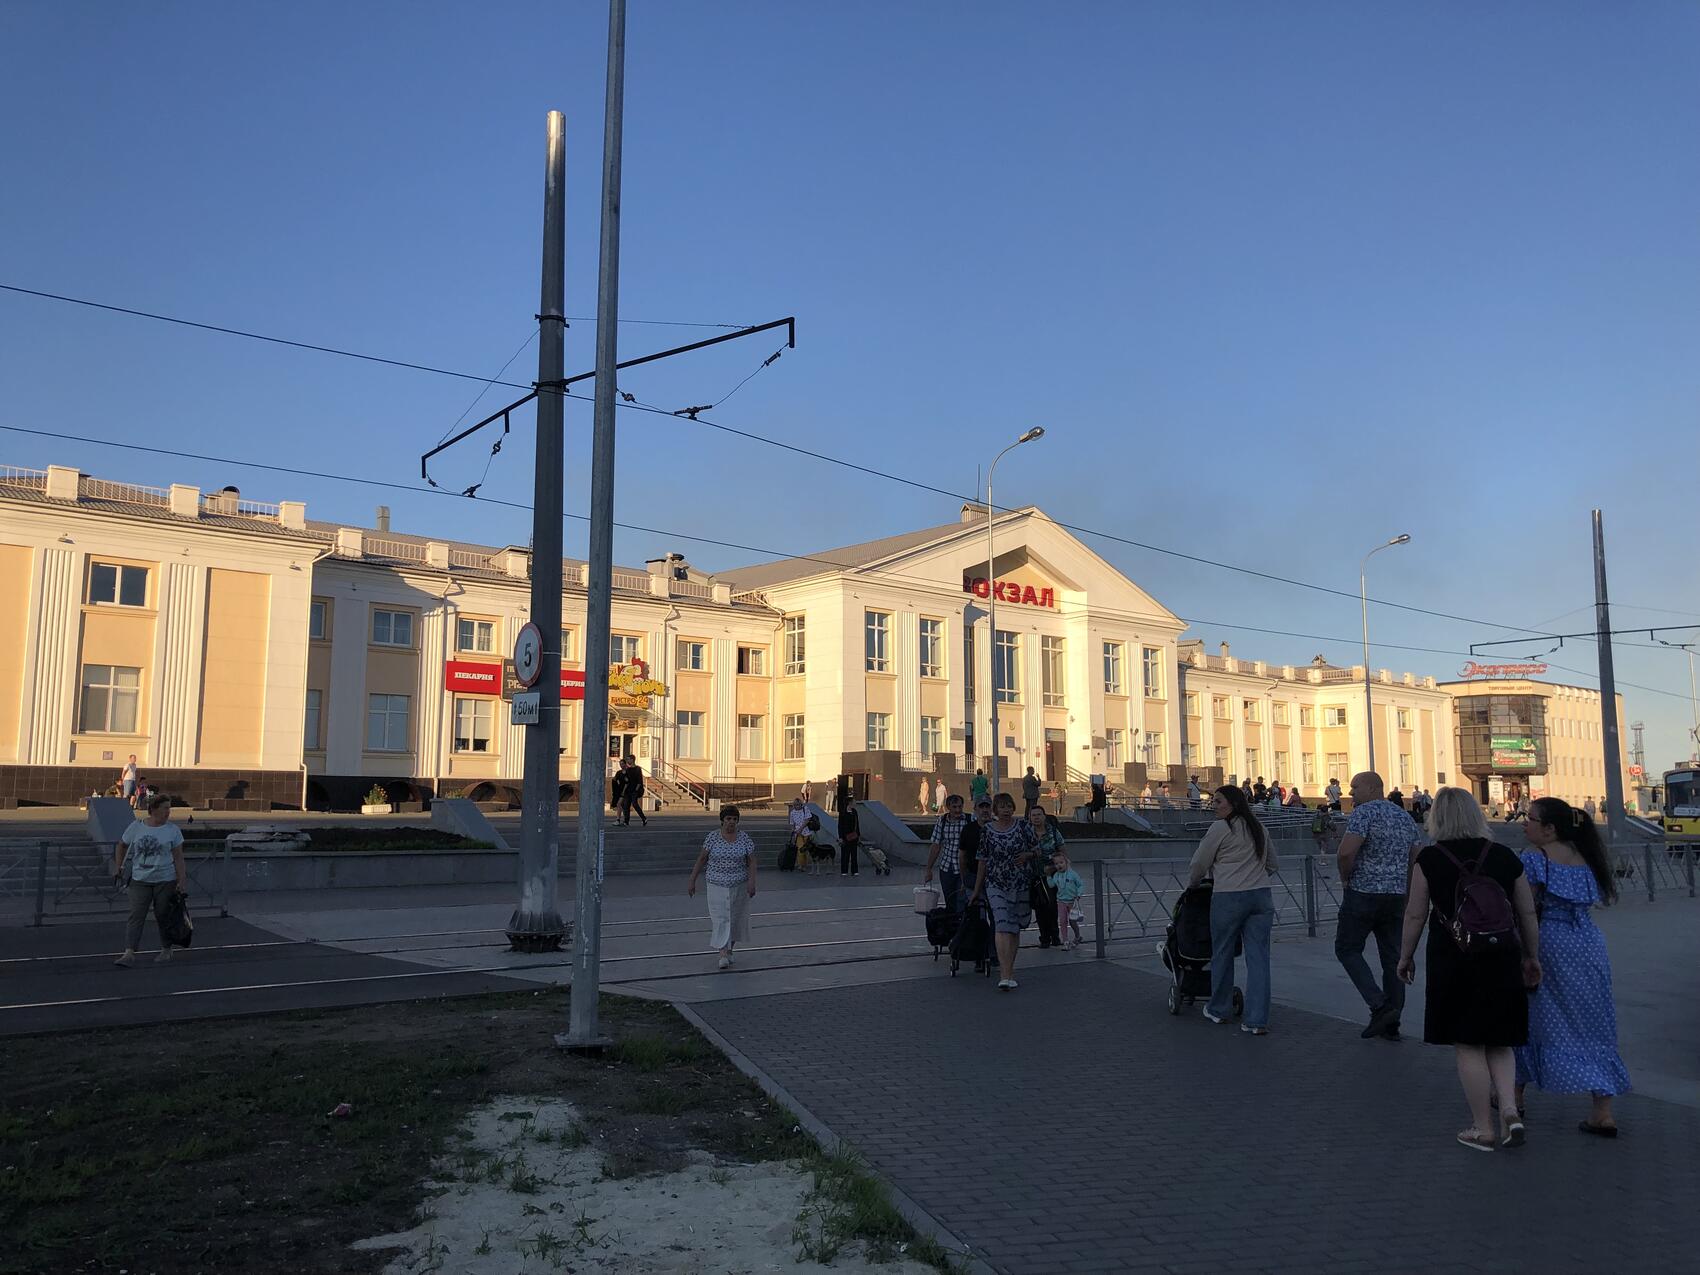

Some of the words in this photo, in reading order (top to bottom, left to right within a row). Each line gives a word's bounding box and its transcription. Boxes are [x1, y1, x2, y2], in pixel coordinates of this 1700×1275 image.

[524, 643, 532, 667] 5
[454, 671, 494, 681] ПЕКАРНЯ
[561, 679, 585, 688] ЦЕРИЯ
[611, 696, 635, 705] БИСТРО
[638, 695, 648, 704] 24
